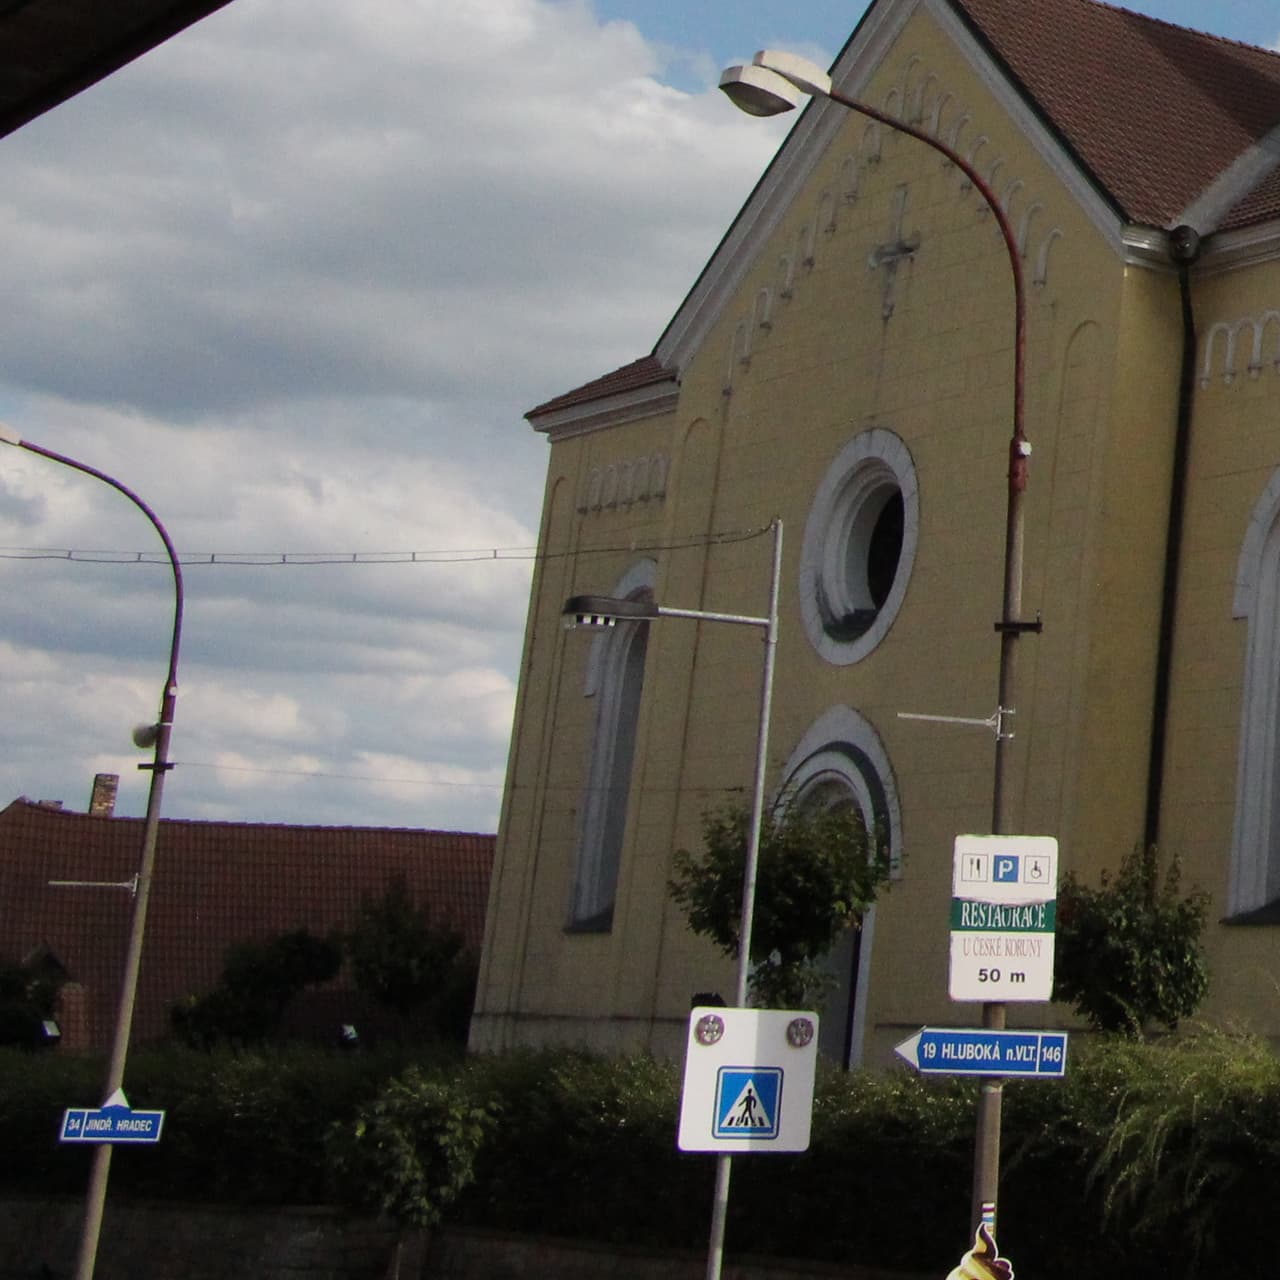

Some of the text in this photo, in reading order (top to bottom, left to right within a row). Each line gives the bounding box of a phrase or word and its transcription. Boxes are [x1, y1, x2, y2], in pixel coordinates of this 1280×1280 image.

[999, 860, 1013, 879] P
[961, 902, 1046, 929] RESTAURACE
[963, 937, 972, 957] U
[1005, 937, 1043, 958] KORUNY
[978, 968, 1025, 983] 50 m
[923, 1040, 1061, 1062] 19 HLUBOKÁ n.VLT. 146
[68, 1119, 81, 1131] 34
[116, 1119, 153, 1132] HRADEC
